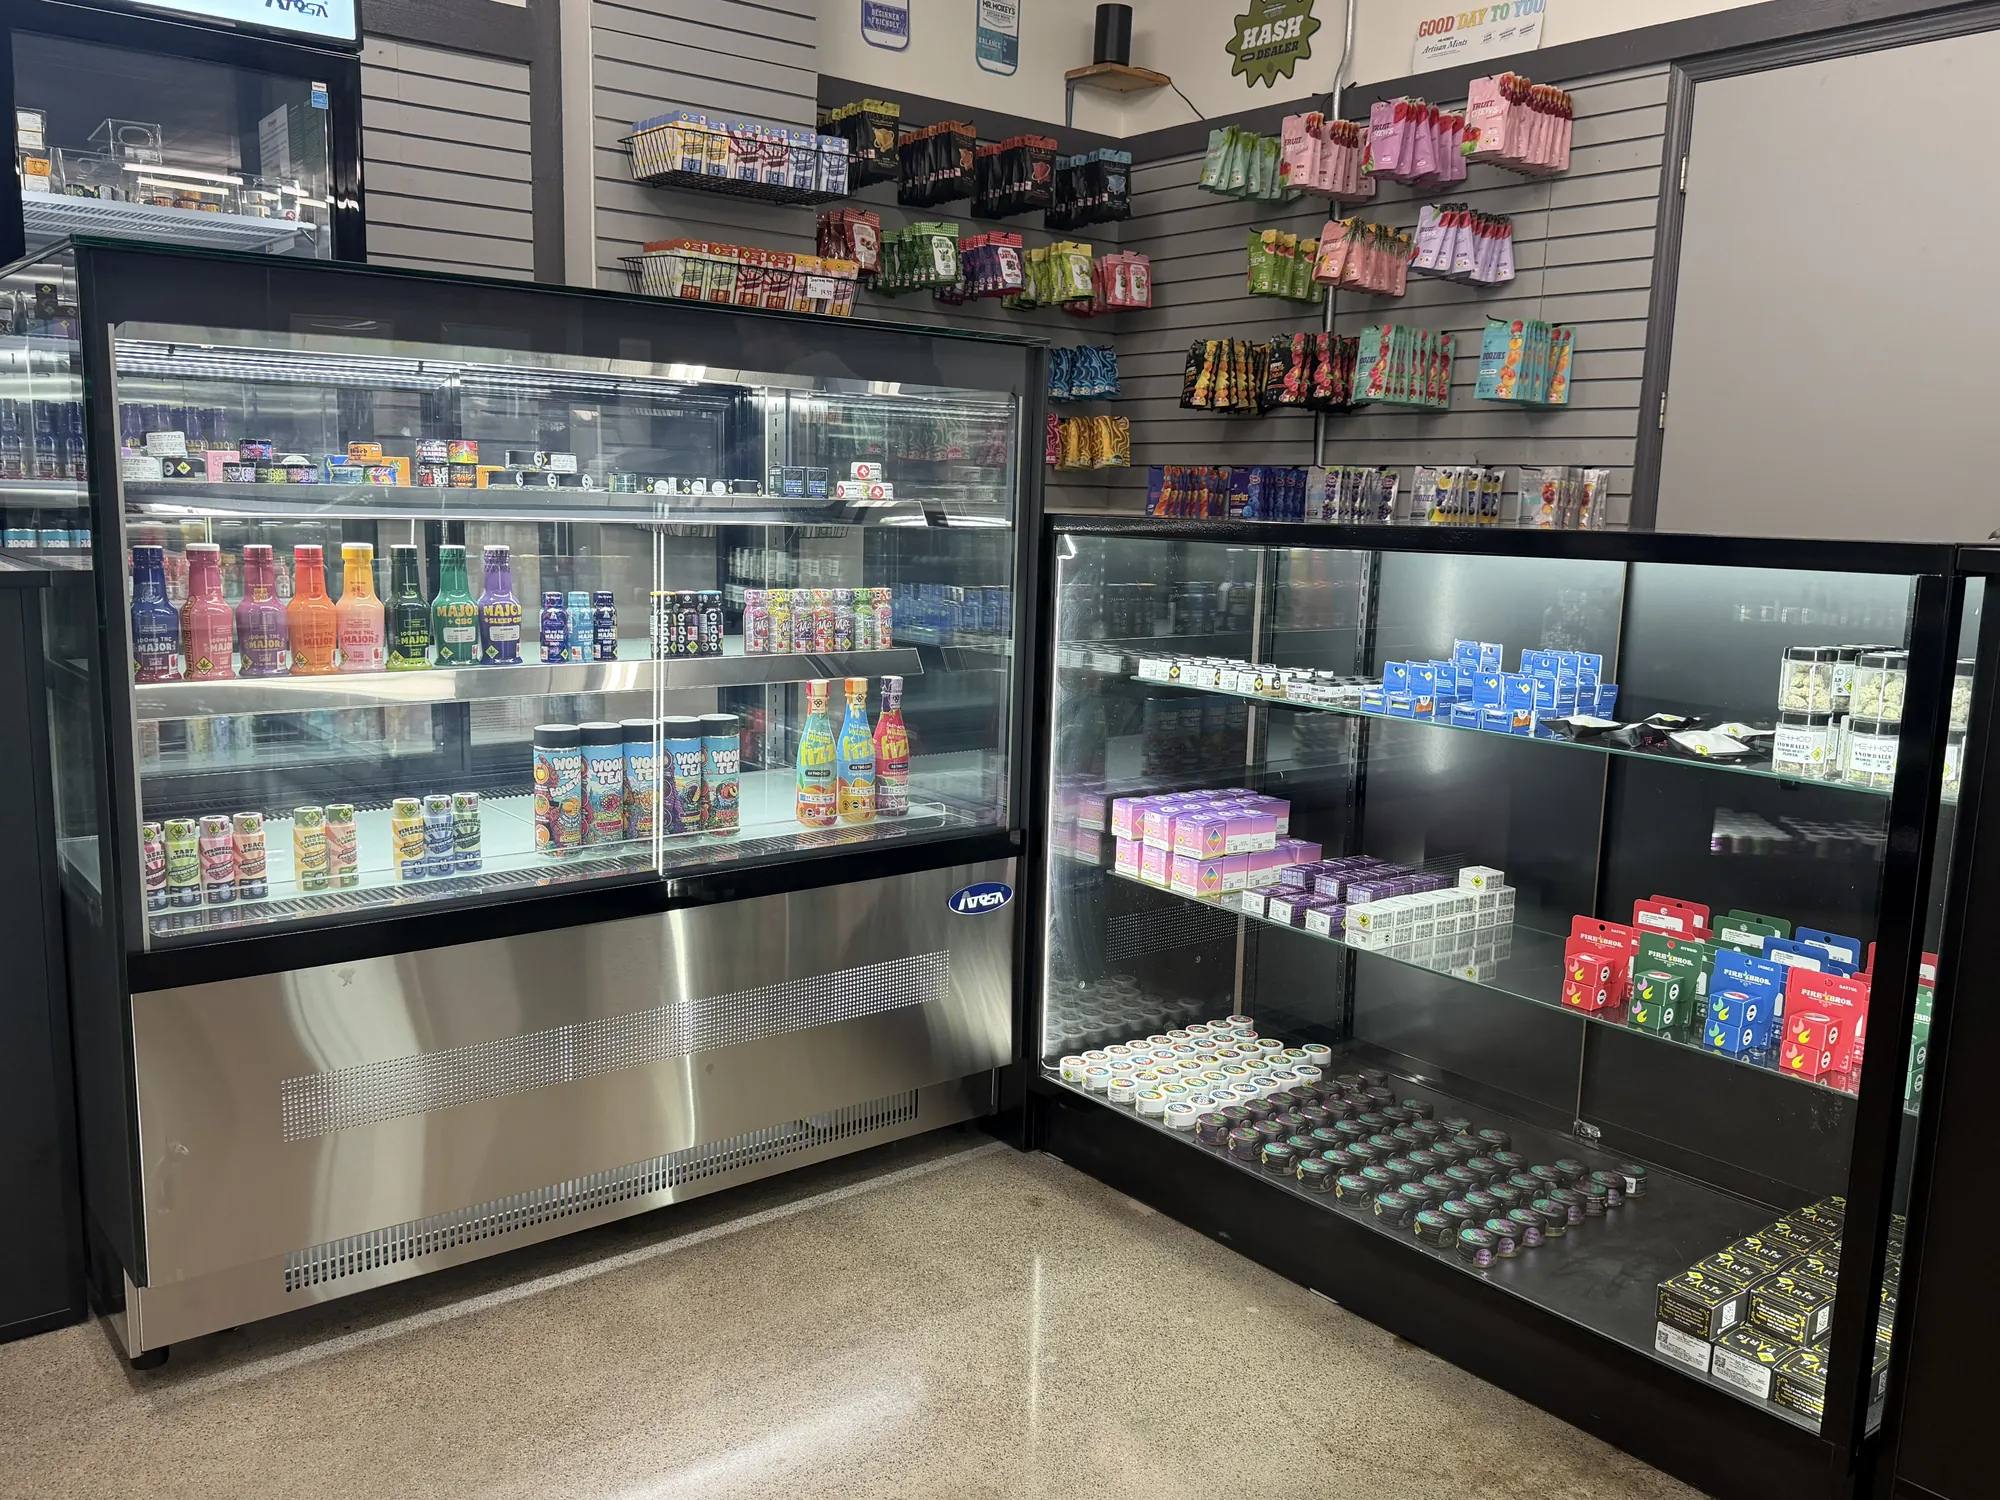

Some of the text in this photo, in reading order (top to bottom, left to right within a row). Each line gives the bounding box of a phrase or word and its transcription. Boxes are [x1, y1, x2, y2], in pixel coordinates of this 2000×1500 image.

[871, 8, 901, 22] BEGINNER
[871, 17, 901, 29] FRIENDLY
[1418, 0, 1545, 38] GOOD DAY TO YOU
[1240, 15, 1304, 50] HASH
[978, 37, 1002, 48] BALANCE
[1256, 40, 1299, 60] DEALER
[1472, 100, 1495, 111] FRUIT
[1360, 356, 1377, 365] OOZIES
[1482, 352, 1505, 361] DOOZIES
[344, 636, 375, 644] MAJOR
[677, 612, 687, 653] dopio
[708, 612, 719, 652] dopio
[138, 643, 172, 652] MAJOR
[210, 642, 233, 652] MAJO
[249, 640, 281, 648] MAJOR
[303, 638, 334, 646] MAJOR
[1776, 741, 1809, 750] SNOWBALLS
[1854, 742, 1894, 753] METHOD
[675, 751, 700, 764] WOO
[801, 741, 837, 767] fizz
[1854, 751, 1892, 760] SNOWBALLS
[170, 853, 197, 861] LEMONADE
[1580, 933, 1624, 949] FIRE BROS.
[1648, 950, 1694, 967] FIRE BROS.
[1724, 968, 1771, 986] FIRE BROS.
[1801, 988, 1853, 1007] FIRE BROS.
[1774, 1226, 1812, 1244] PARIS
[1743, 1242, 1782, 1259] PARIS
[1716, 1257, 1755, 1275] PARIS
[1684, 1275, 1724, 1295] PARIS
[1775, 1282, 1817, 1301] PARIS
[1735, 1333, 1777, 1353] PARIS
[1800, 1359, 1828, 1375] PAR
